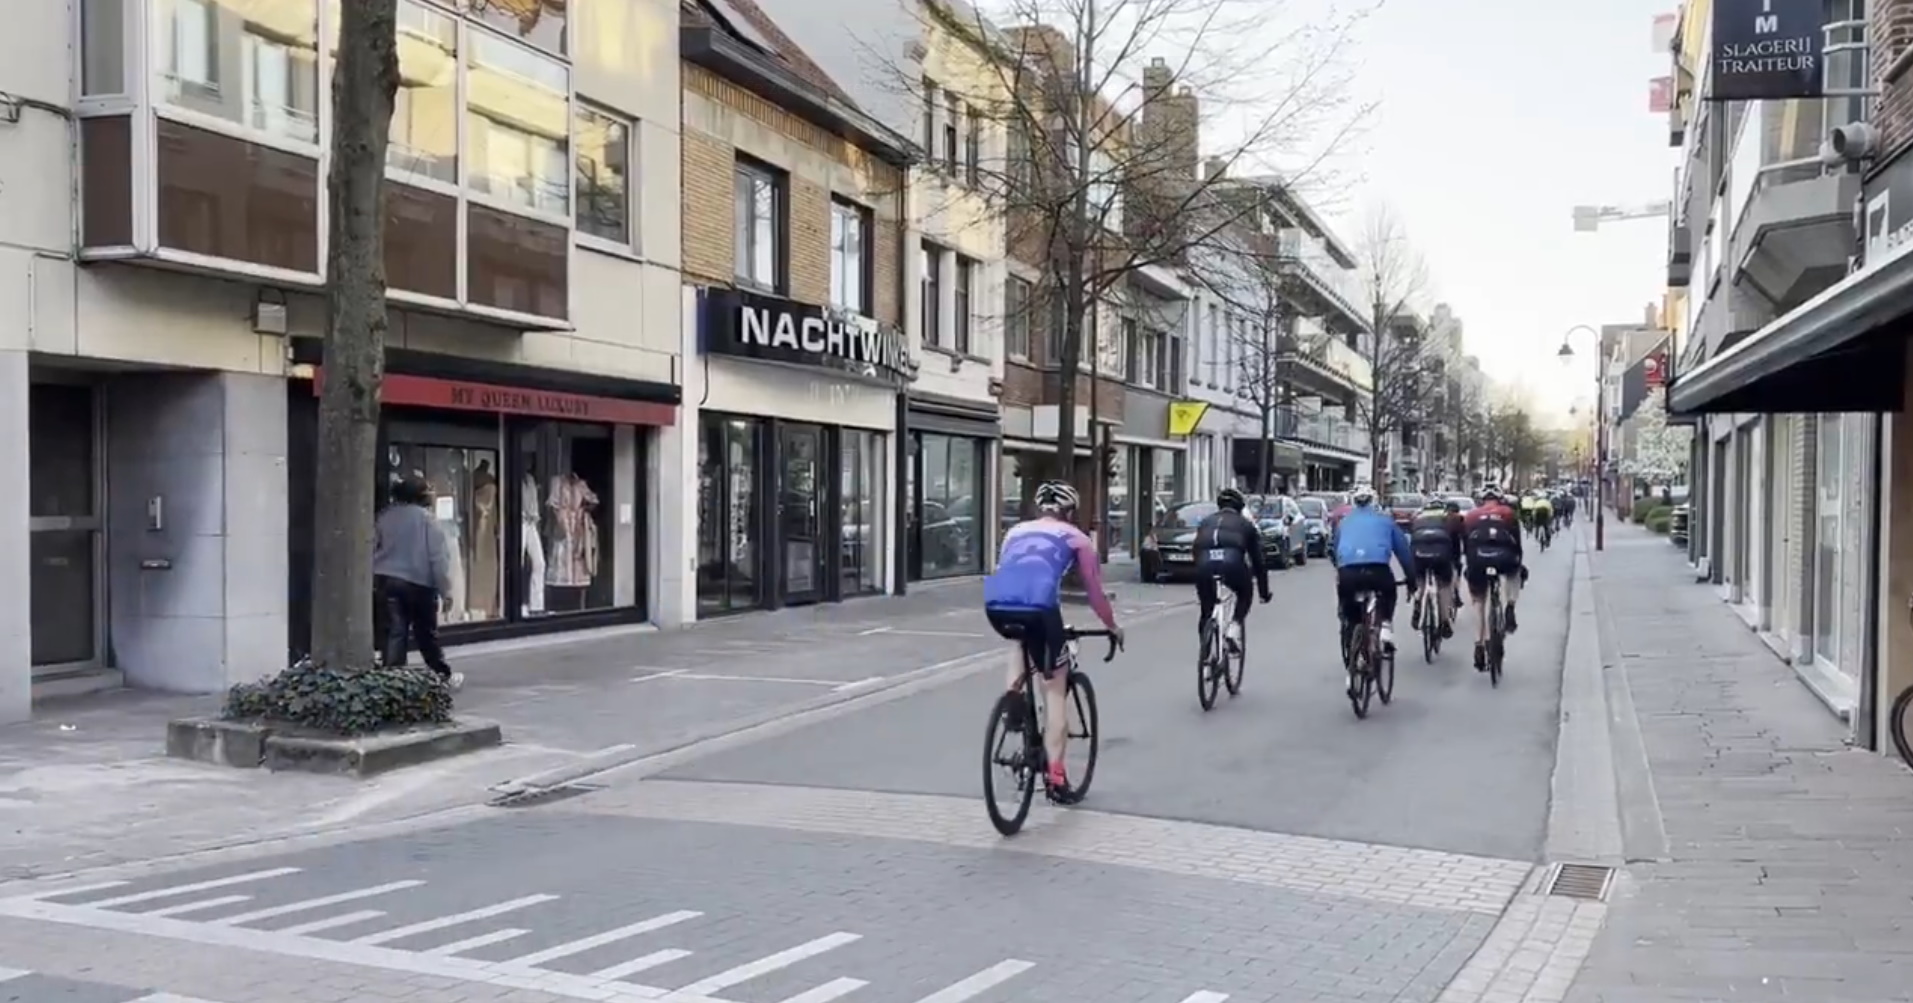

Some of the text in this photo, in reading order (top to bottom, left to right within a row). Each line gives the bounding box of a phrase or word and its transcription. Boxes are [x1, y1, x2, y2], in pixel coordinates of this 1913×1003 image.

[1723, 36, 1811, 57] SLAGERIJ
[1719, 55, 1814, 74] TRAITEUR
[481, 389, 531, 410] QUEEN
